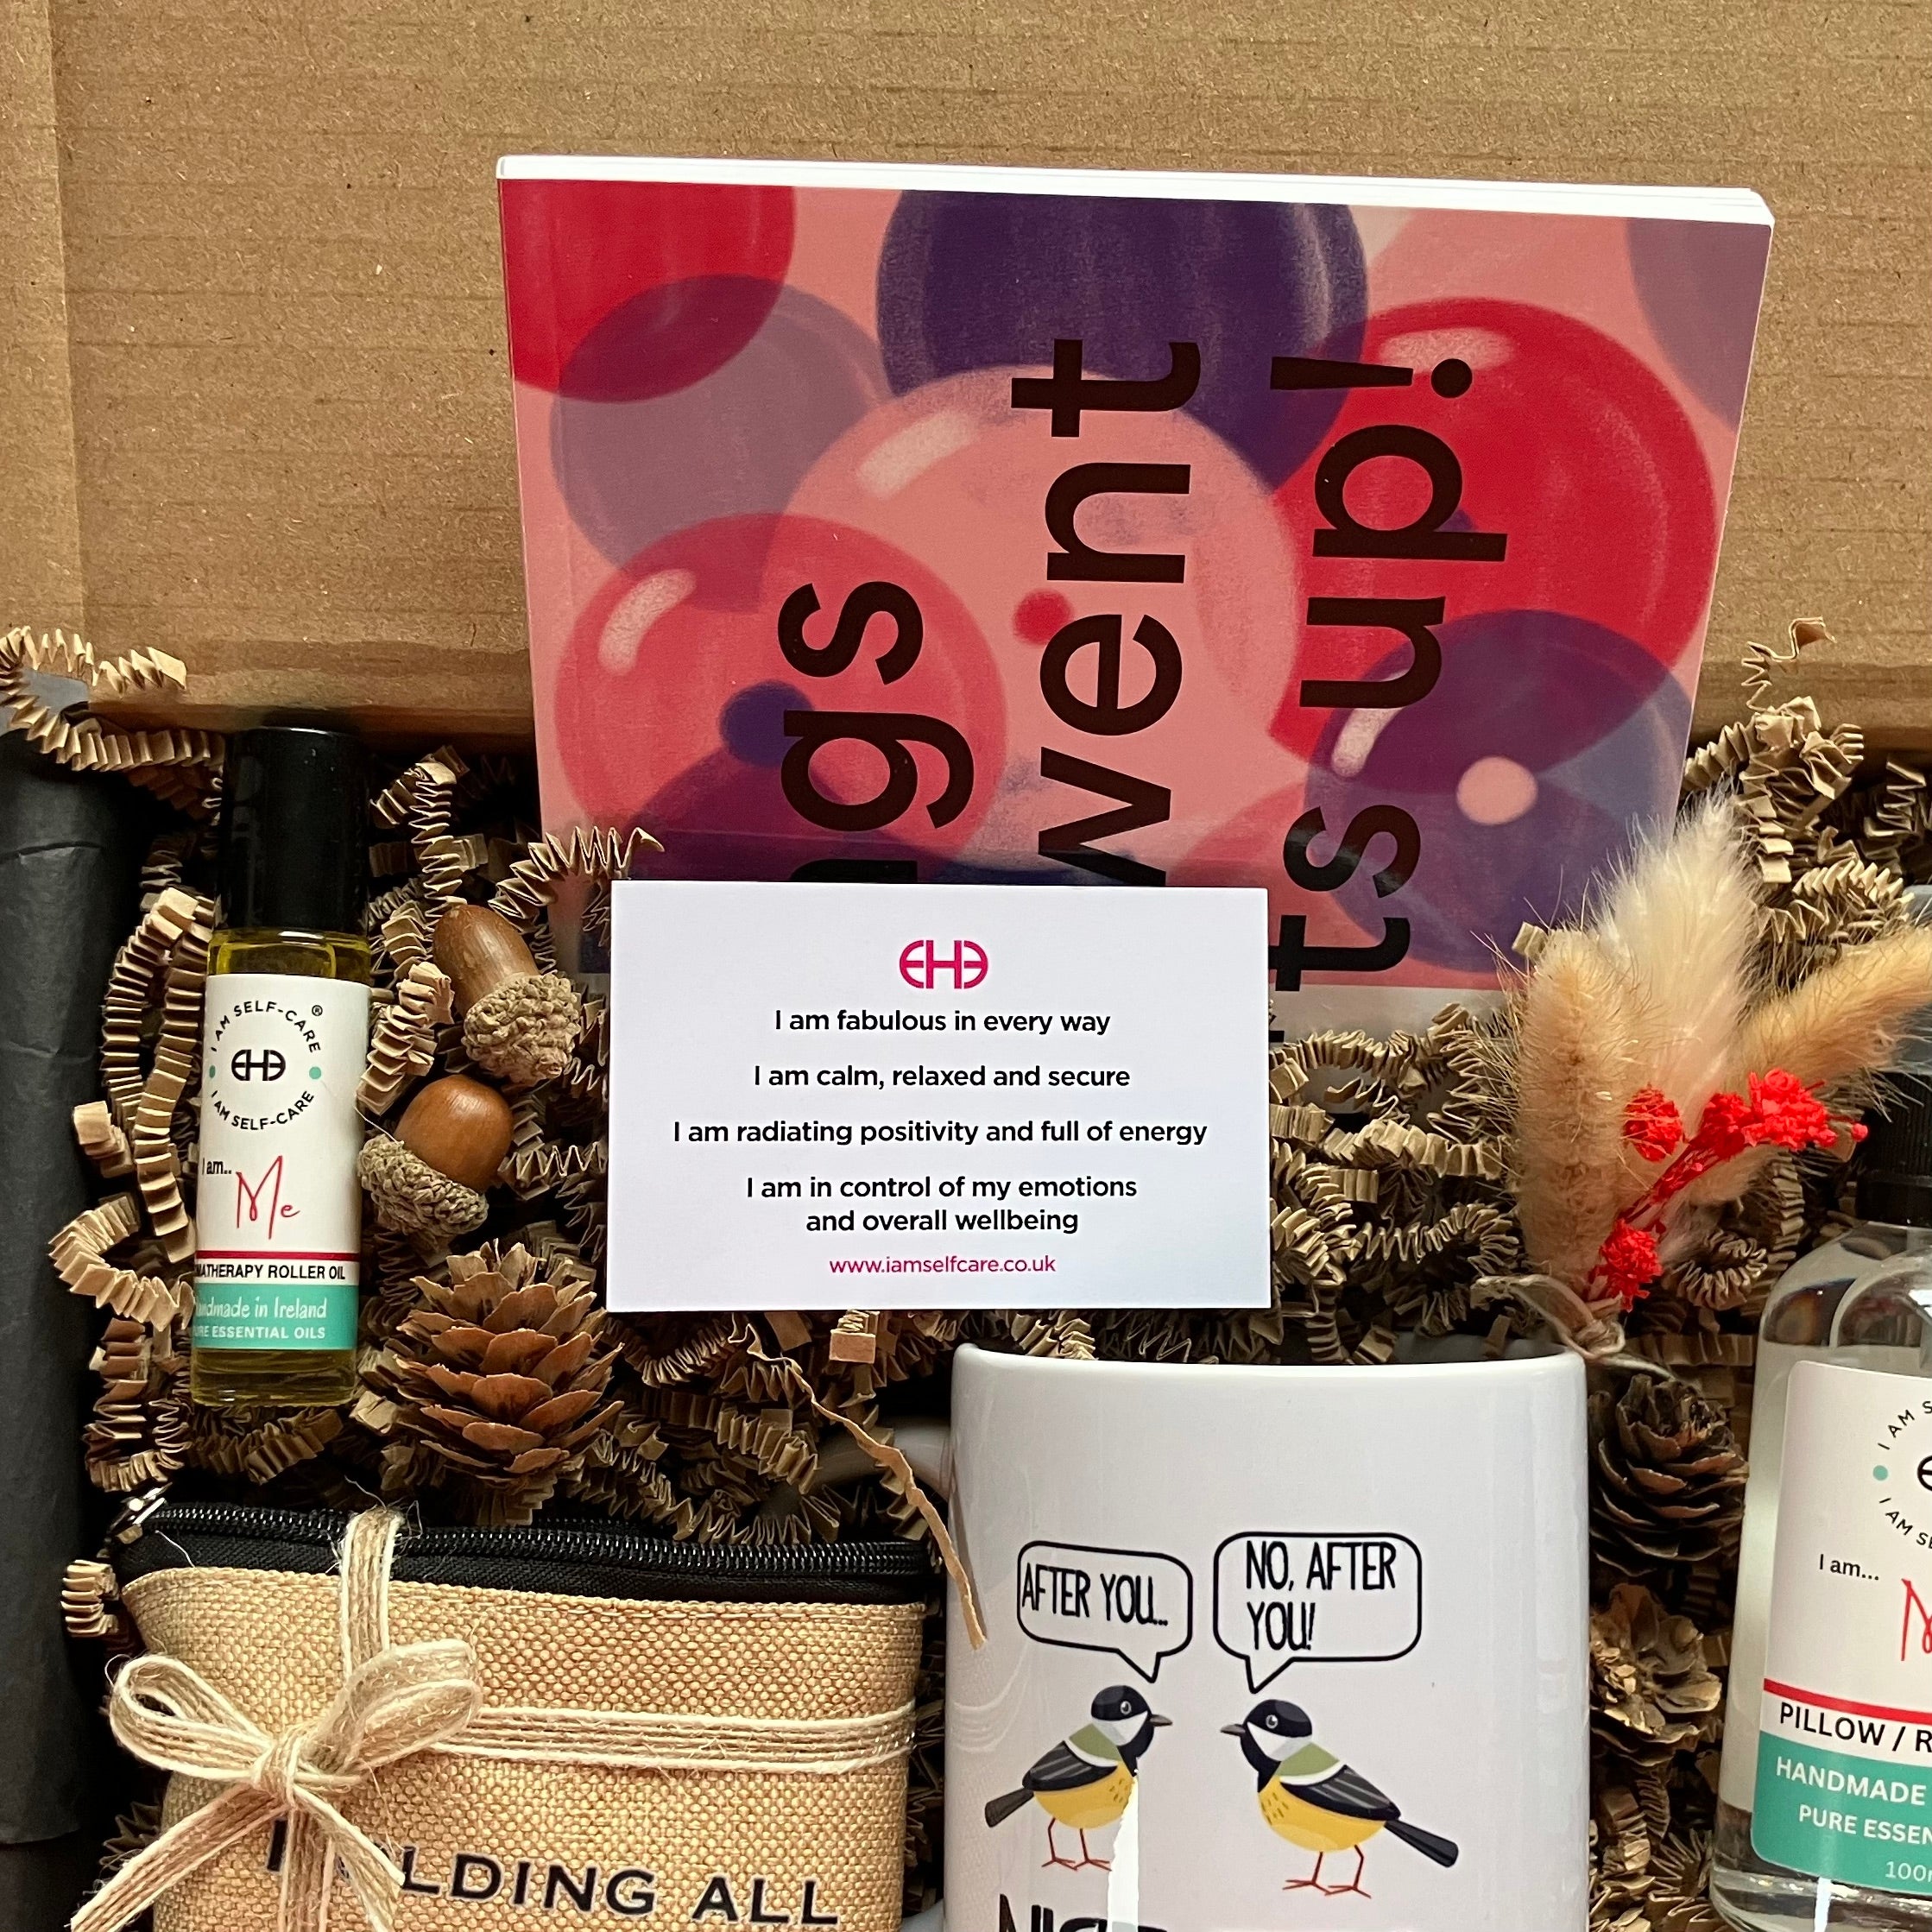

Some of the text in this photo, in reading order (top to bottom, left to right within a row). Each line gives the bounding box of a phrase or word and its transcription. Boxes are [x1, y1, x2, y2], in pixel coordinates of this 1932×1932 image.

[1010, 338, 1202, 887] went
[1268, 356, 1508, 1042] ts up!
[215, 1015, 230, 1041] AM
[233, 1000, 322, 1053] SELF-CARE
[775, 1009, 1111, 1036] I am fabulous in every way
[754, 1064, 1131, 1090] I am calm, relaxed and secure
[213, 1100, 230, 1121] AM
[230, 1090, 315, 1131] SELF-CARE
[674, 1120, 1208, 1146] I am radiating positivity and full of energy
[235, 1155, 300, 1241] Me
[747, 1175, 1137, 1203] I am in control of my emotions
[805, 1209, 1078, 1234] and overall wellbeing
[268, 1265, 325, 1279] ROLLER
[329, 1266, 346, 1279] OIL
[829, 1254, 1056, 1274] www.iamselfcare.co.uk
[255, 1296, 268, 1318] in
[274, 1296, 328, 1319] Ireland
[212, 1326, 289, 1339] ESSENTIAL
[294, 1327, 326, 1339] OILS
[1887, 1409, 1916, 1439] AM
[1885, 1511, 1914, 1537] AM
[1246, 1540, 1397, 1591] NO, AFTER
[1819, 1553, 1879, 1581] I am...
[1021, 1562, 1091, 1618] AFTER
[1247, 1601, 1316, 1651] YOU!
[1779, 1701, 1886, 1746] PILLOW
[1776, 1755, 1927, 1806] HANDMADE
[1798, 1803, 1858, 1835] PURE
[267, 1819, 839, 1926] LDING ALL
[1885, 1860, 1932, 1882] 100
